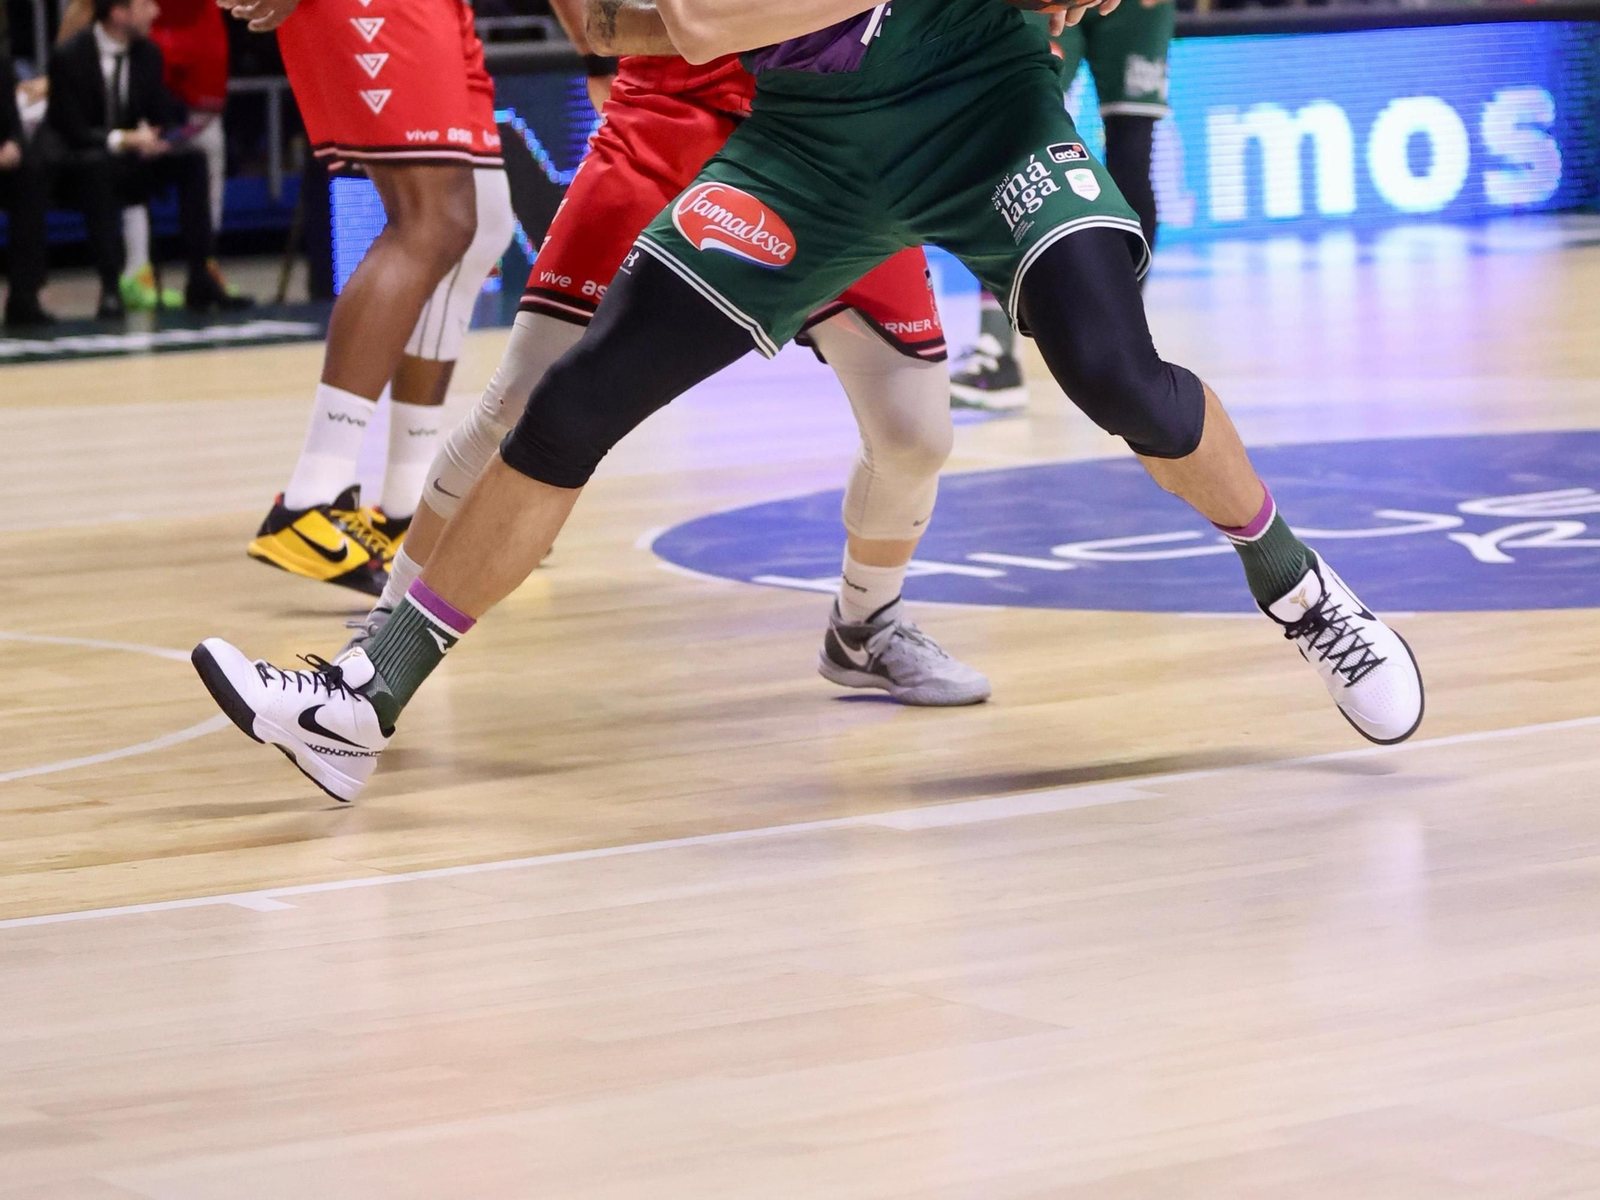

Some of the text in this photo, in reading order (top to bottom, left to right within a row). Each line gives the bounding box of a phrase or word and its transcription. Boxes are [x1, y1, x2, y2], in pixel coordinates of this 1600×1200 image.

[1055, 150, 1080, 160] acb
[991, 173, 1010, 202] sabor
[994, 198, 1002, 210] a
[1001, 178, 1061, 232] laga
[678, 187, 791, 260] famadesa
[540, 270, 572, 288] vive
[880, 319, 932, 334] RNER
